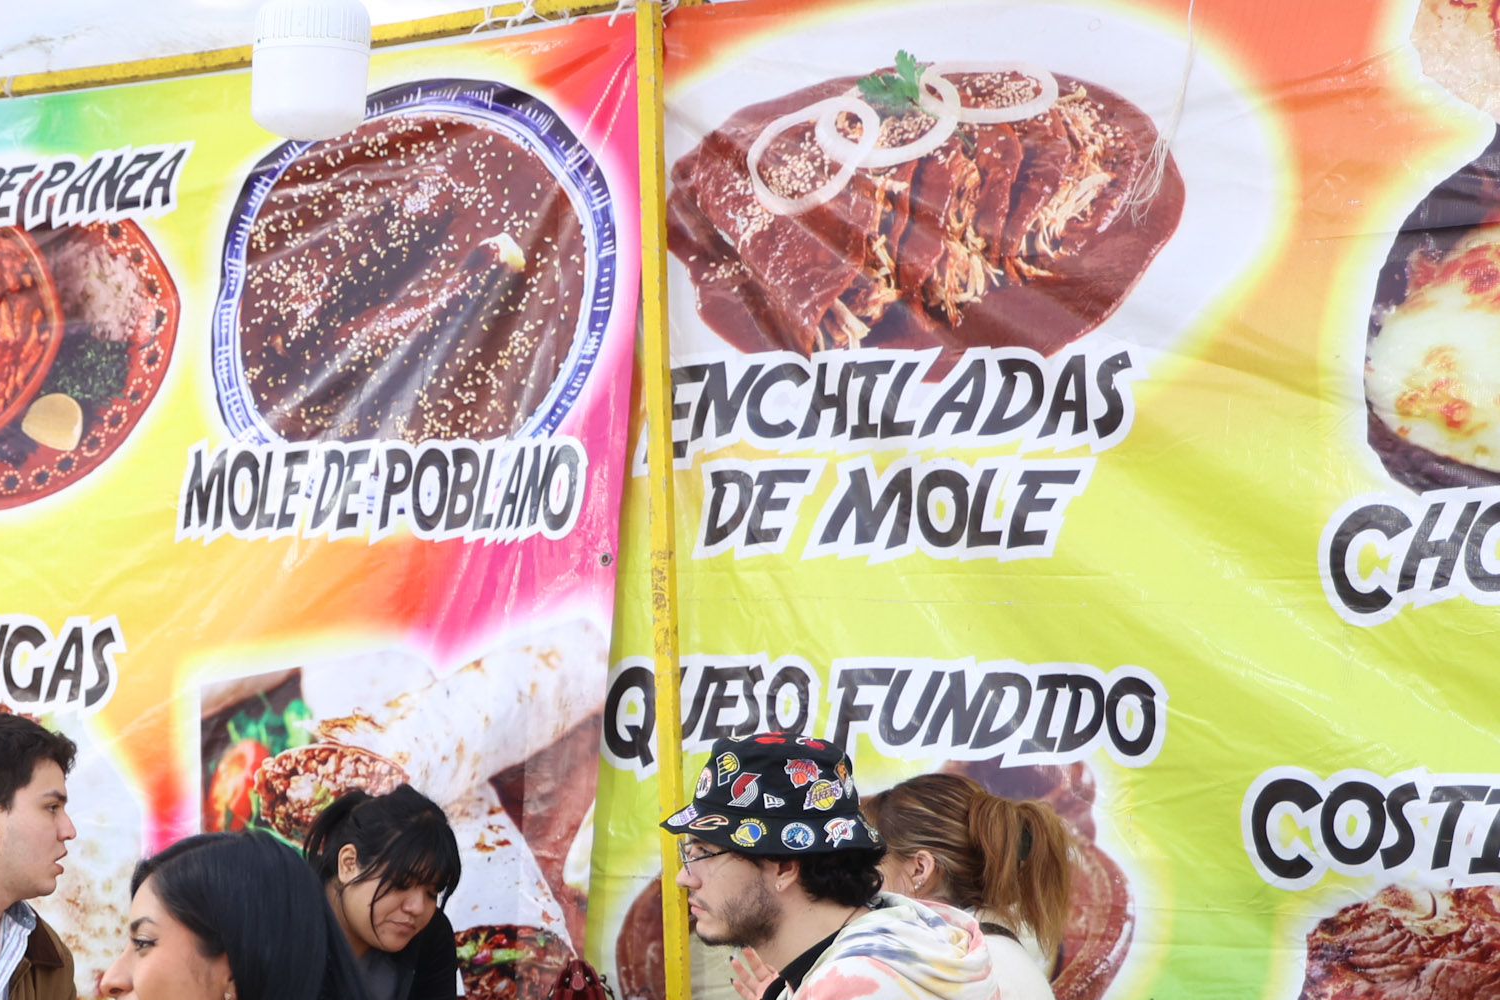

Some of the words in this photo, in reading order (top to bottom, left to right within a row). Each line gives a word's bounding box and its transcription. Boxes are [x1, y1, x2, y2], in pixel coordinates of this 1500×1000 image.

[30, 148, 188, 221] PANZA
[643, 349, 1133, 464] ENCHILADAS
[183, 444, 303, 532] MOLE
[311, 446, 374, 531] DE
[377, 444, 580, 534] POBLANO
[703, 467, 812, 547] DE
[818, 466, 1083, 550] MOLE
[828, 667, 1157, 758] FUNDIDO
